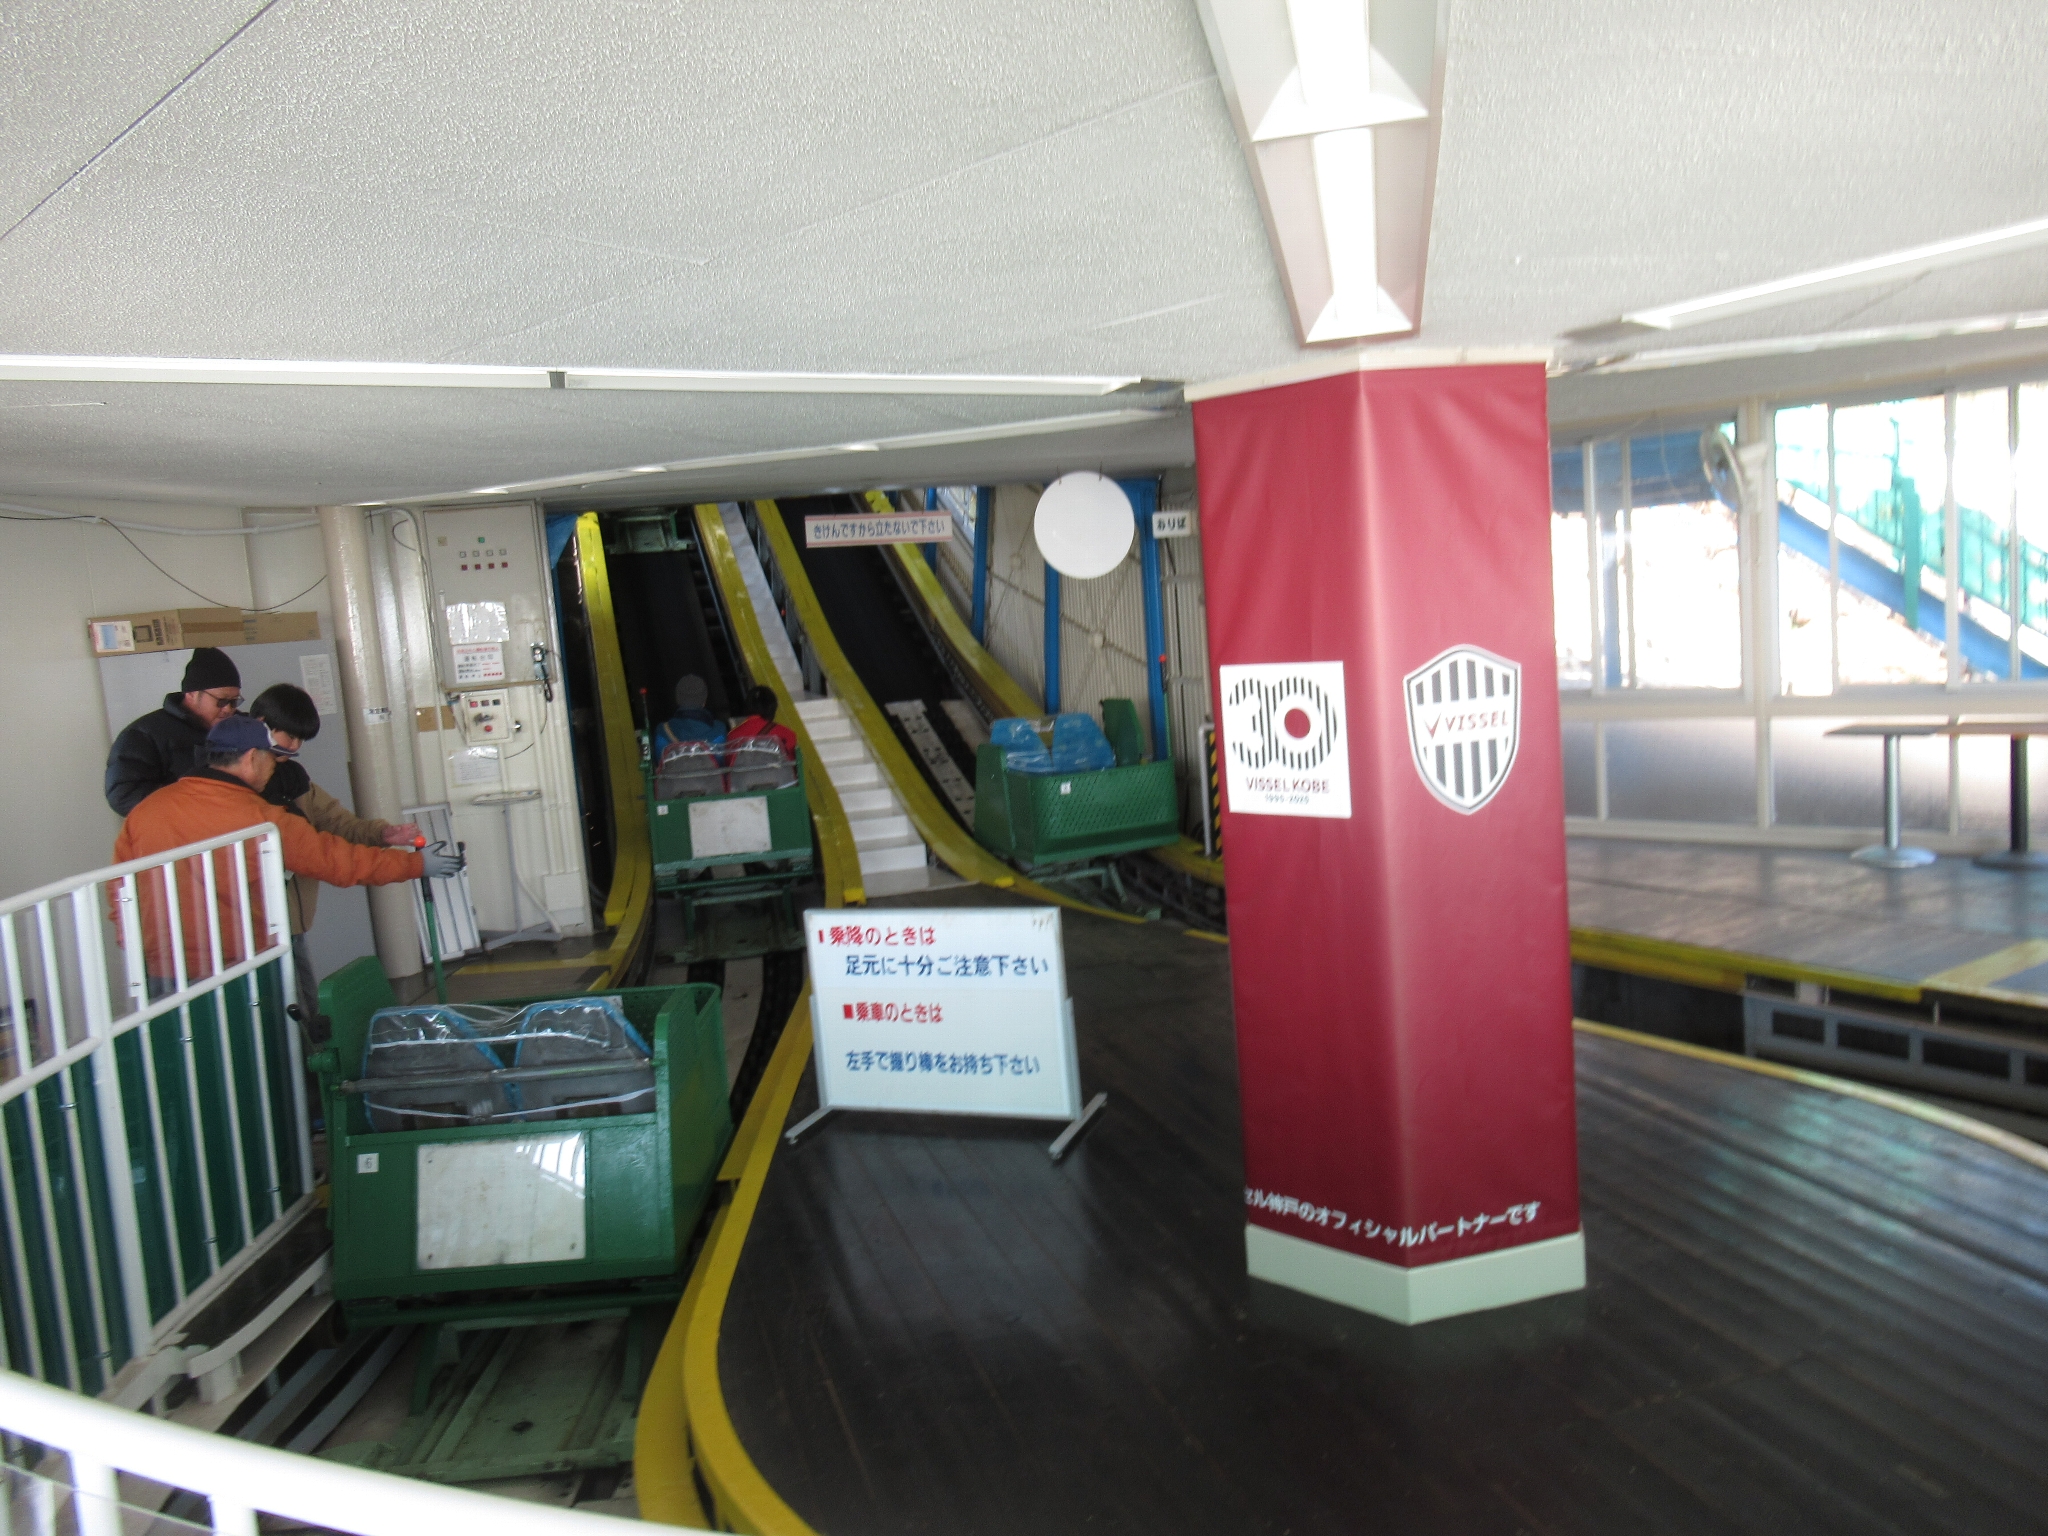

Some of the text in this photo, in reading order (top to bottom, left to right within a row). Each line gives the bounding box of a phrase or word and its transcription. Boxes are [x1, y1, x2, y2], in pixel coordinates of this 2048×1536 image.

[814, 518, 945, 540] きけんですから立たないで下さい
[1157, 516, 1187, 531] おりば
[1228, 676, 1338, 771] 30
[1445, 710, 1508, 732] VISSEL
[1246, 777, 1330, 794] VISSEL KOBE
[845, 954, 1049, 977] 足元に十分ご注意下さい
